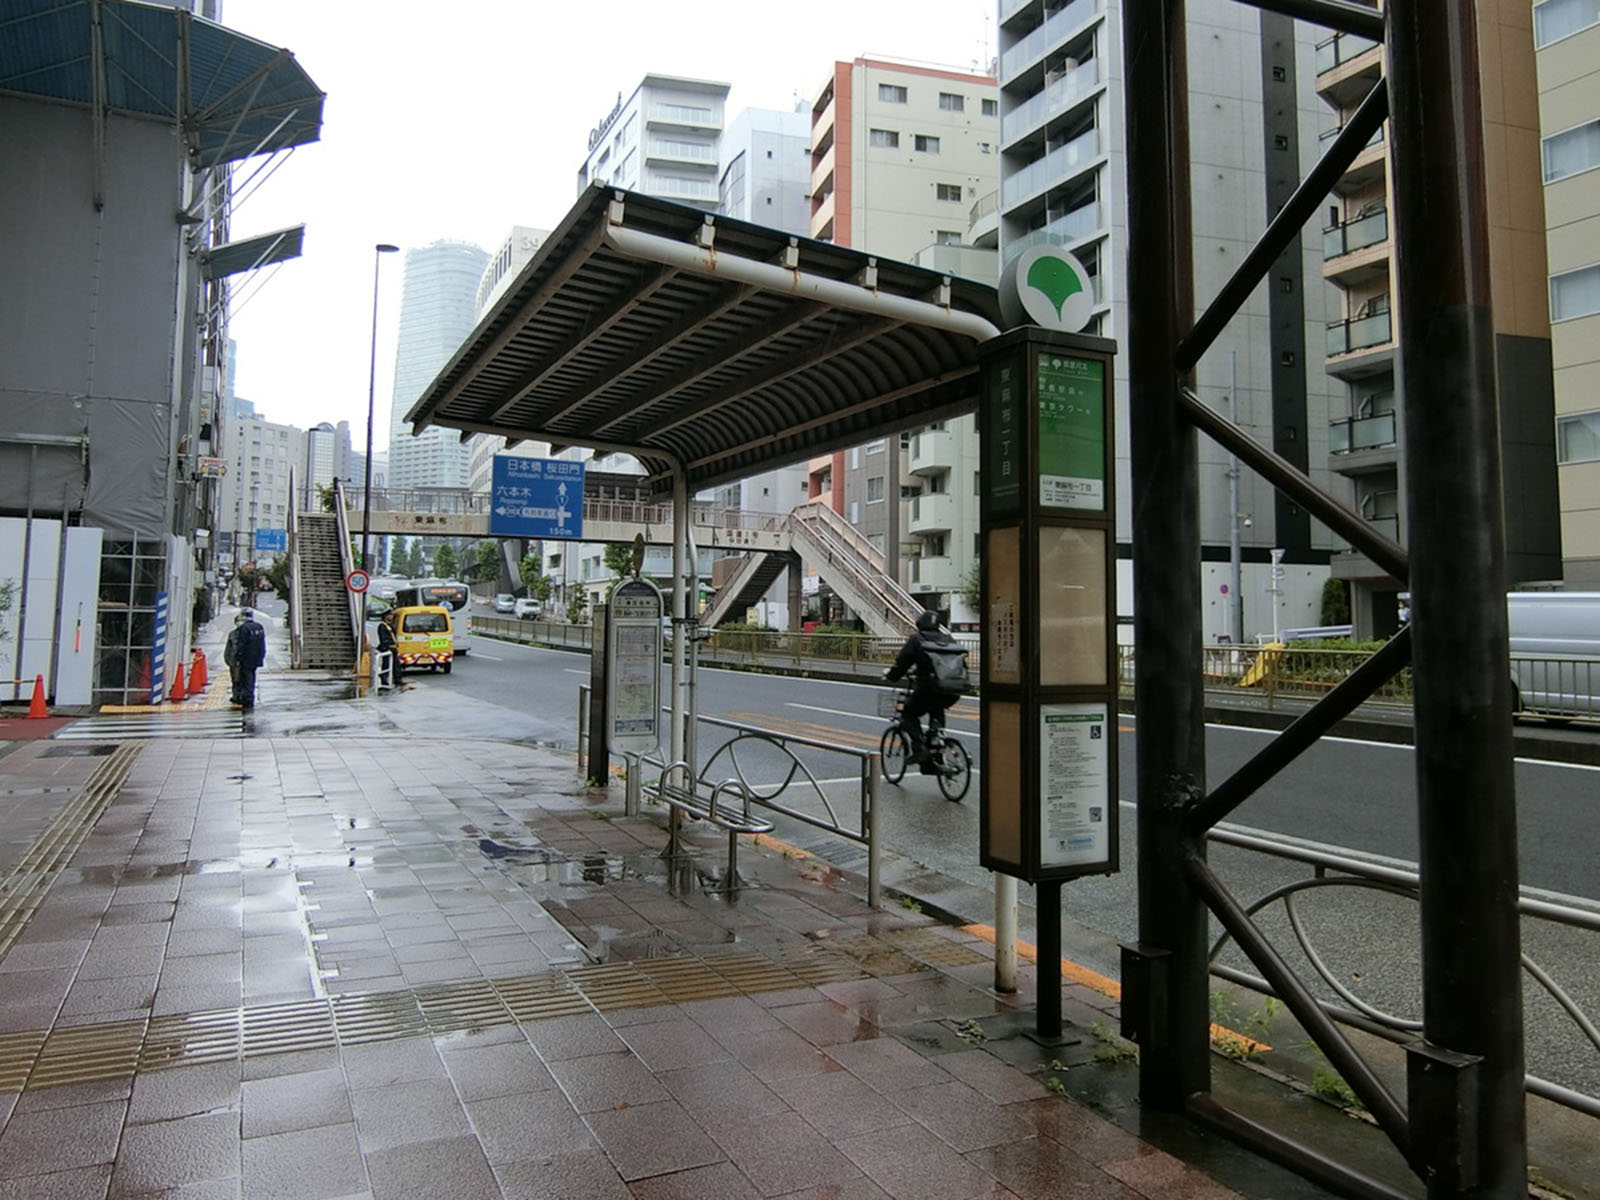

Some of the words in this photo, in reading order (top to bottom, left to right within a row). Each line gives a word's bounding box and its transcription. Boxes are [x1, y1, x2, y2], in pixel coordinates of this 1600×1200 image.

[507, 459, 542, 472] 日本橋
[546, 462, 581, 475] 桜田門
[496, 486, 532, 498] 六本木
[352, 576, 365, 588] 50
